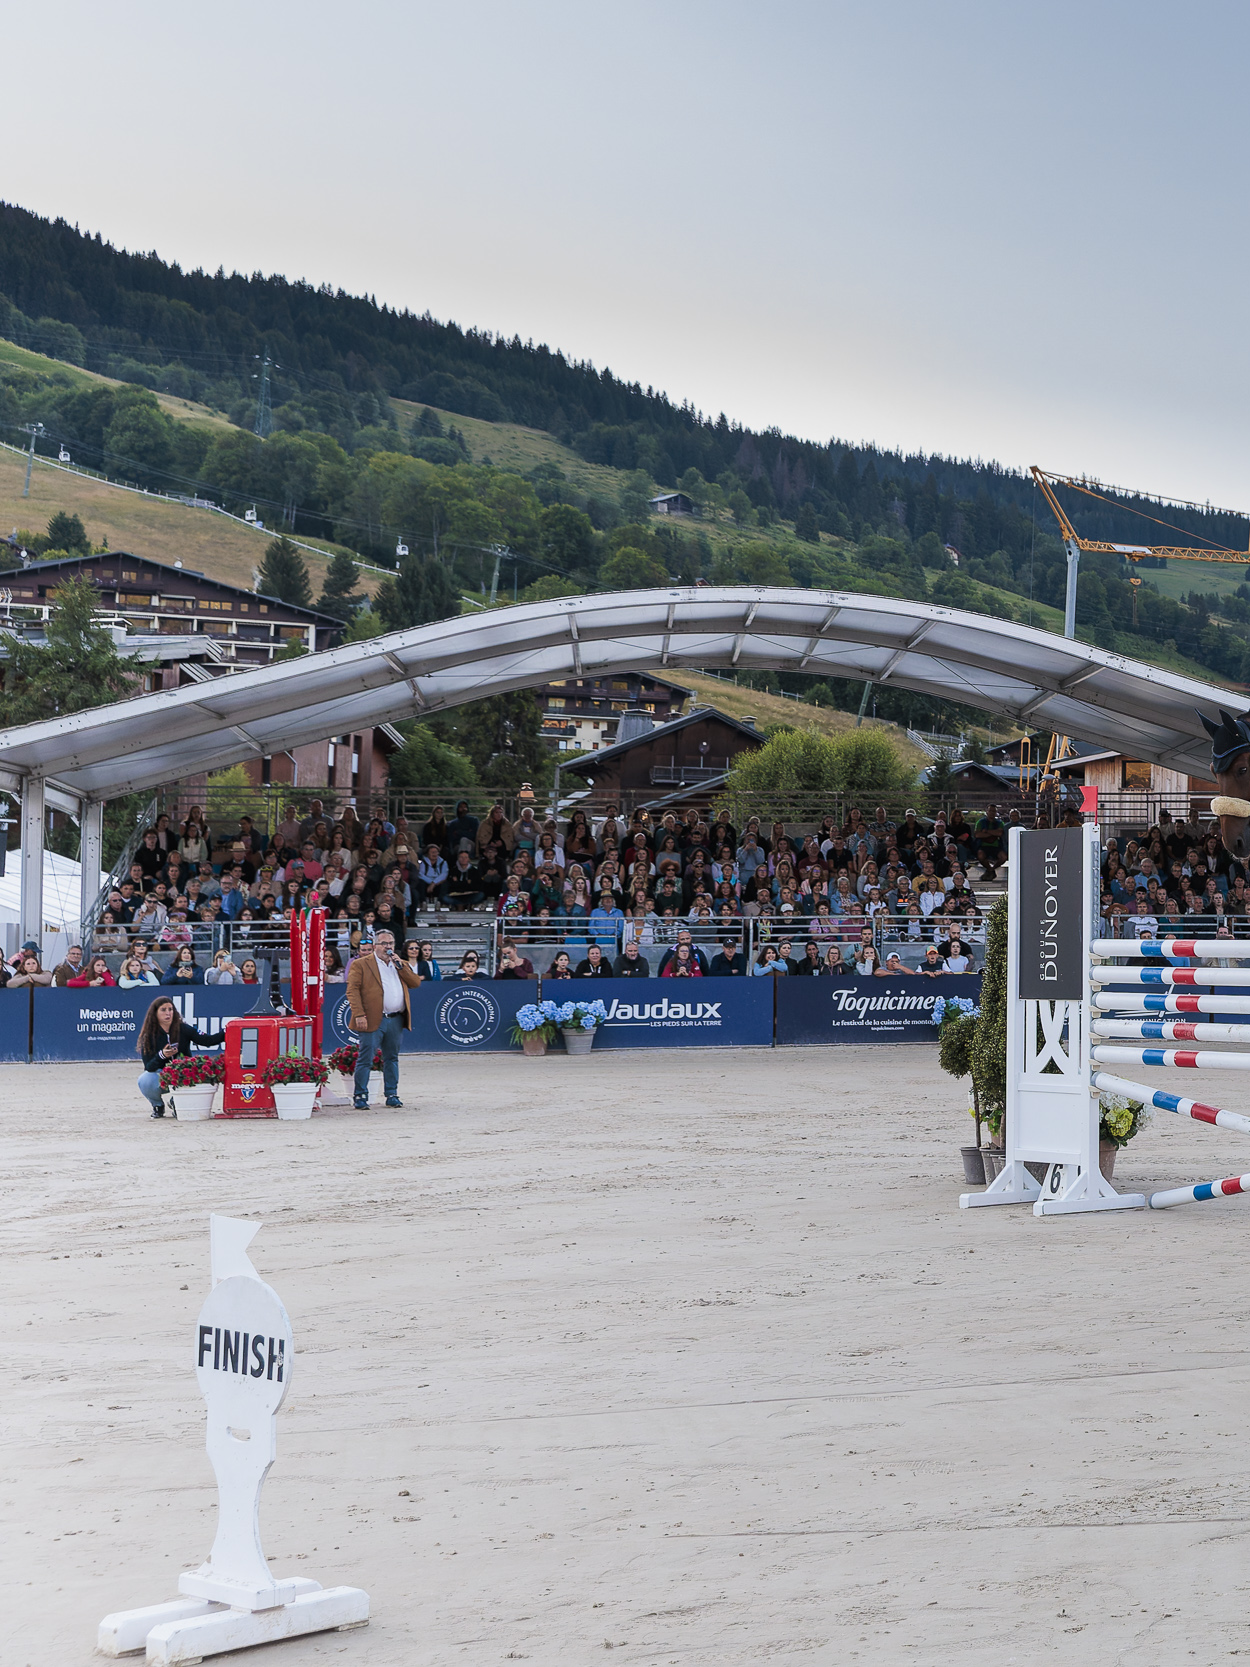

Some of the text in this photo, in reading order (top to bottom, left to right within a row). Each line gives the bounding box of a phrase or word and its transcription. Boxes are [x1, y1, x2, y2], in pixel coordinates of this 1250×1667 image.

[1044, 846, 1058, 982] DUNOYER
[79, 1008, 134, 1022] Megève en
[439, 997, 453, 1024] JUMPING
[462, 990, 495, 1023] INTERNATIONAL
[597, 998, 722, 1020] Vaudaux
[76, 1021, 136, 1034] un magazine
[911, 1019, 937, 1027] montag
[1050, 1163, 1064, 1194] 6
[198, 1325, 285, 1383] FINISH
